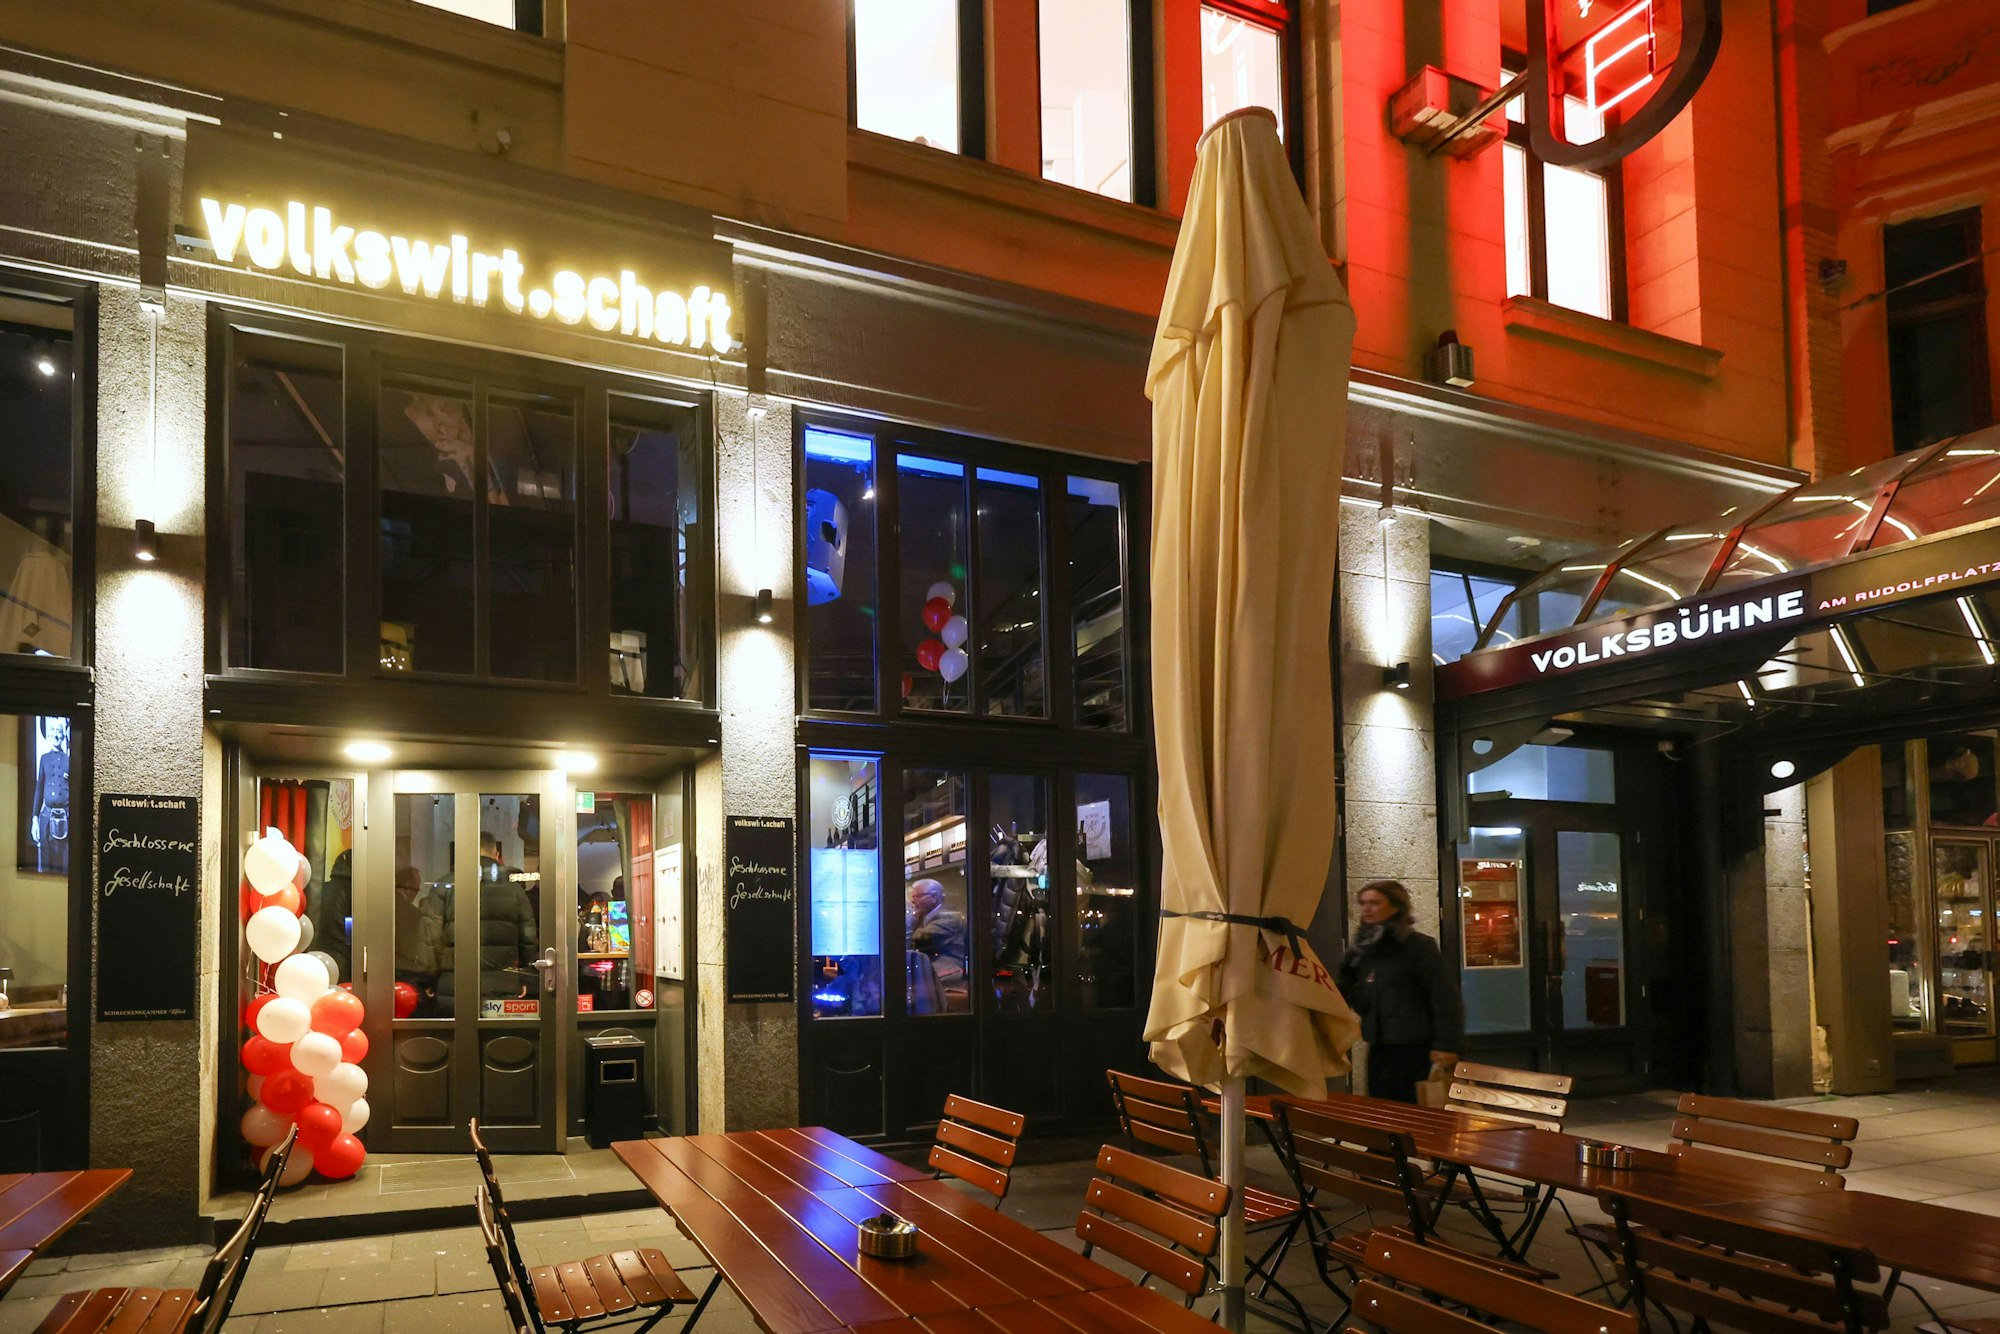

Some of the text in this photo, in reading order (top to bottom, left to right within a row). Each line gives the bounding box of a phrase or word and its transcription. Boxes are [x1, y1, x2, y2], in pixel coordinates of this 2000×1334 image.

[200, 197, 733, 354] volkswirt.schaft
[1818, 596, 1847, 610] AM
[1531, 590, 1804, 673] VOLKSBÜHNE
[103, 828, 194, 853] Geschlossene
[104, 866, 191, 896] Gesellschaft
[483, 1002, 536, 1012] sky sport
